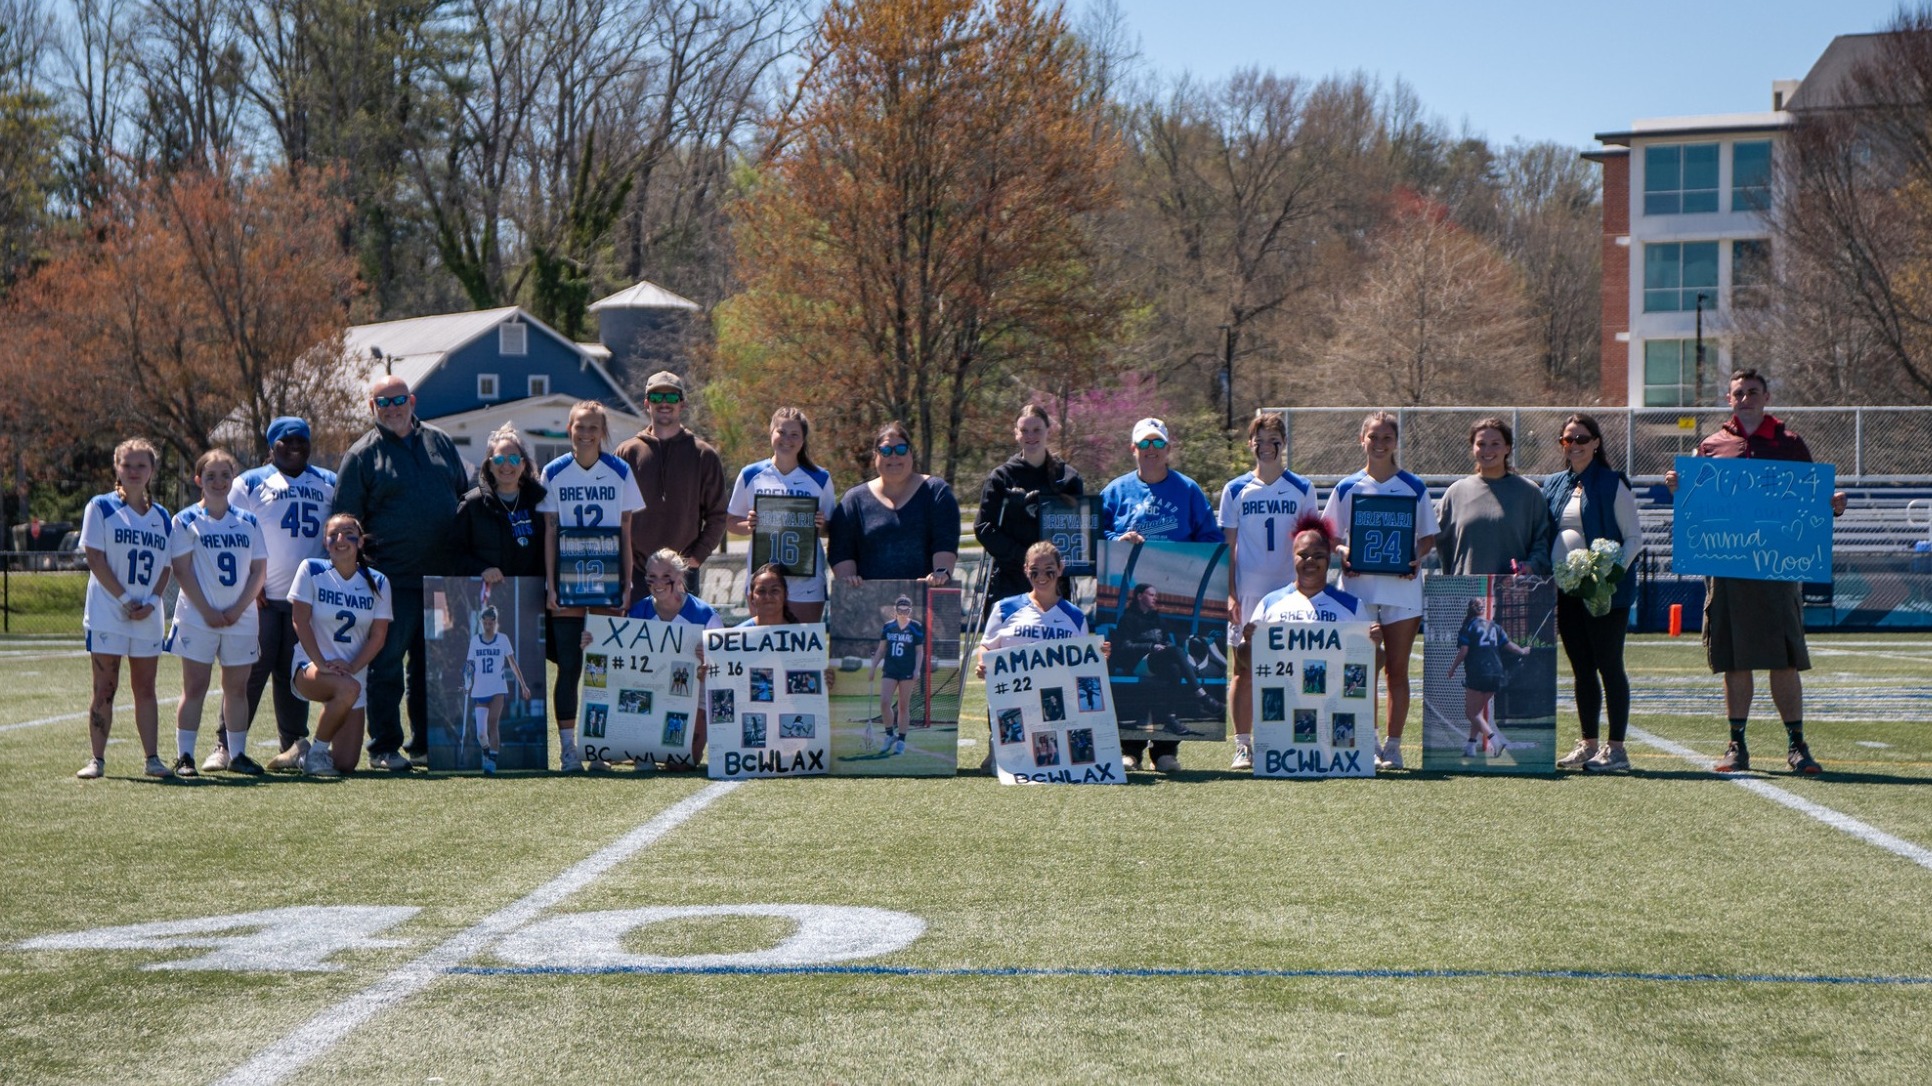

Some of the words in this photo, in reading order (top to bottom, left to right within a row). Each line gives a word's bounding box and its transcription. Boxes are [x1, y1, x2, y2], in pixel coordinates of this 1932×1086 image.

[272, 485, 324, 502] BREVARD
[559, 486, 616, 501] BREVARD
[573, 504, 604, 527] 12
[1242, 499, 1297, 515] BREVARD
[280, 502, 320, 538] 45
[115, 528, 166, 551] BREVARD
[200, 533, 250, 549] BREVARD
[1264, 517, 1275, 551] 1
[1686, 525, 1767, 551] Emma
[769, 530, 799, 566] 16
[1052, 533, 1089, 567] 22
[1363, 530, 1401, 564] 24
[1753, 544, 1823, 574] Moo!
[127, 548, 155, 586] 13
[217, 551, 237, 587] 9
[575, 560, 605, 594] 12
[318, 588, 374, 610] BREVARD
[333, 609, 357, 643] 2
[1280, 610, 1337, 622] BREVARD
[602, 617, 683, 654] XAN
[708, 630, 823, 652] DELAINA
[1014, 625, 1073, 640] BREVARD
[1268, 626, 1342, 650] EMMA
[1477, 626, 1498, 646] 24
[891, 642, 904, 657] 16
[994, 644, 1099, 676] AMANDA
[482, 657, 494, 674] 12
[1013, 762, 1116, 784] BCWLAX
[1266, 749, 1361, 773] BCWLAX
